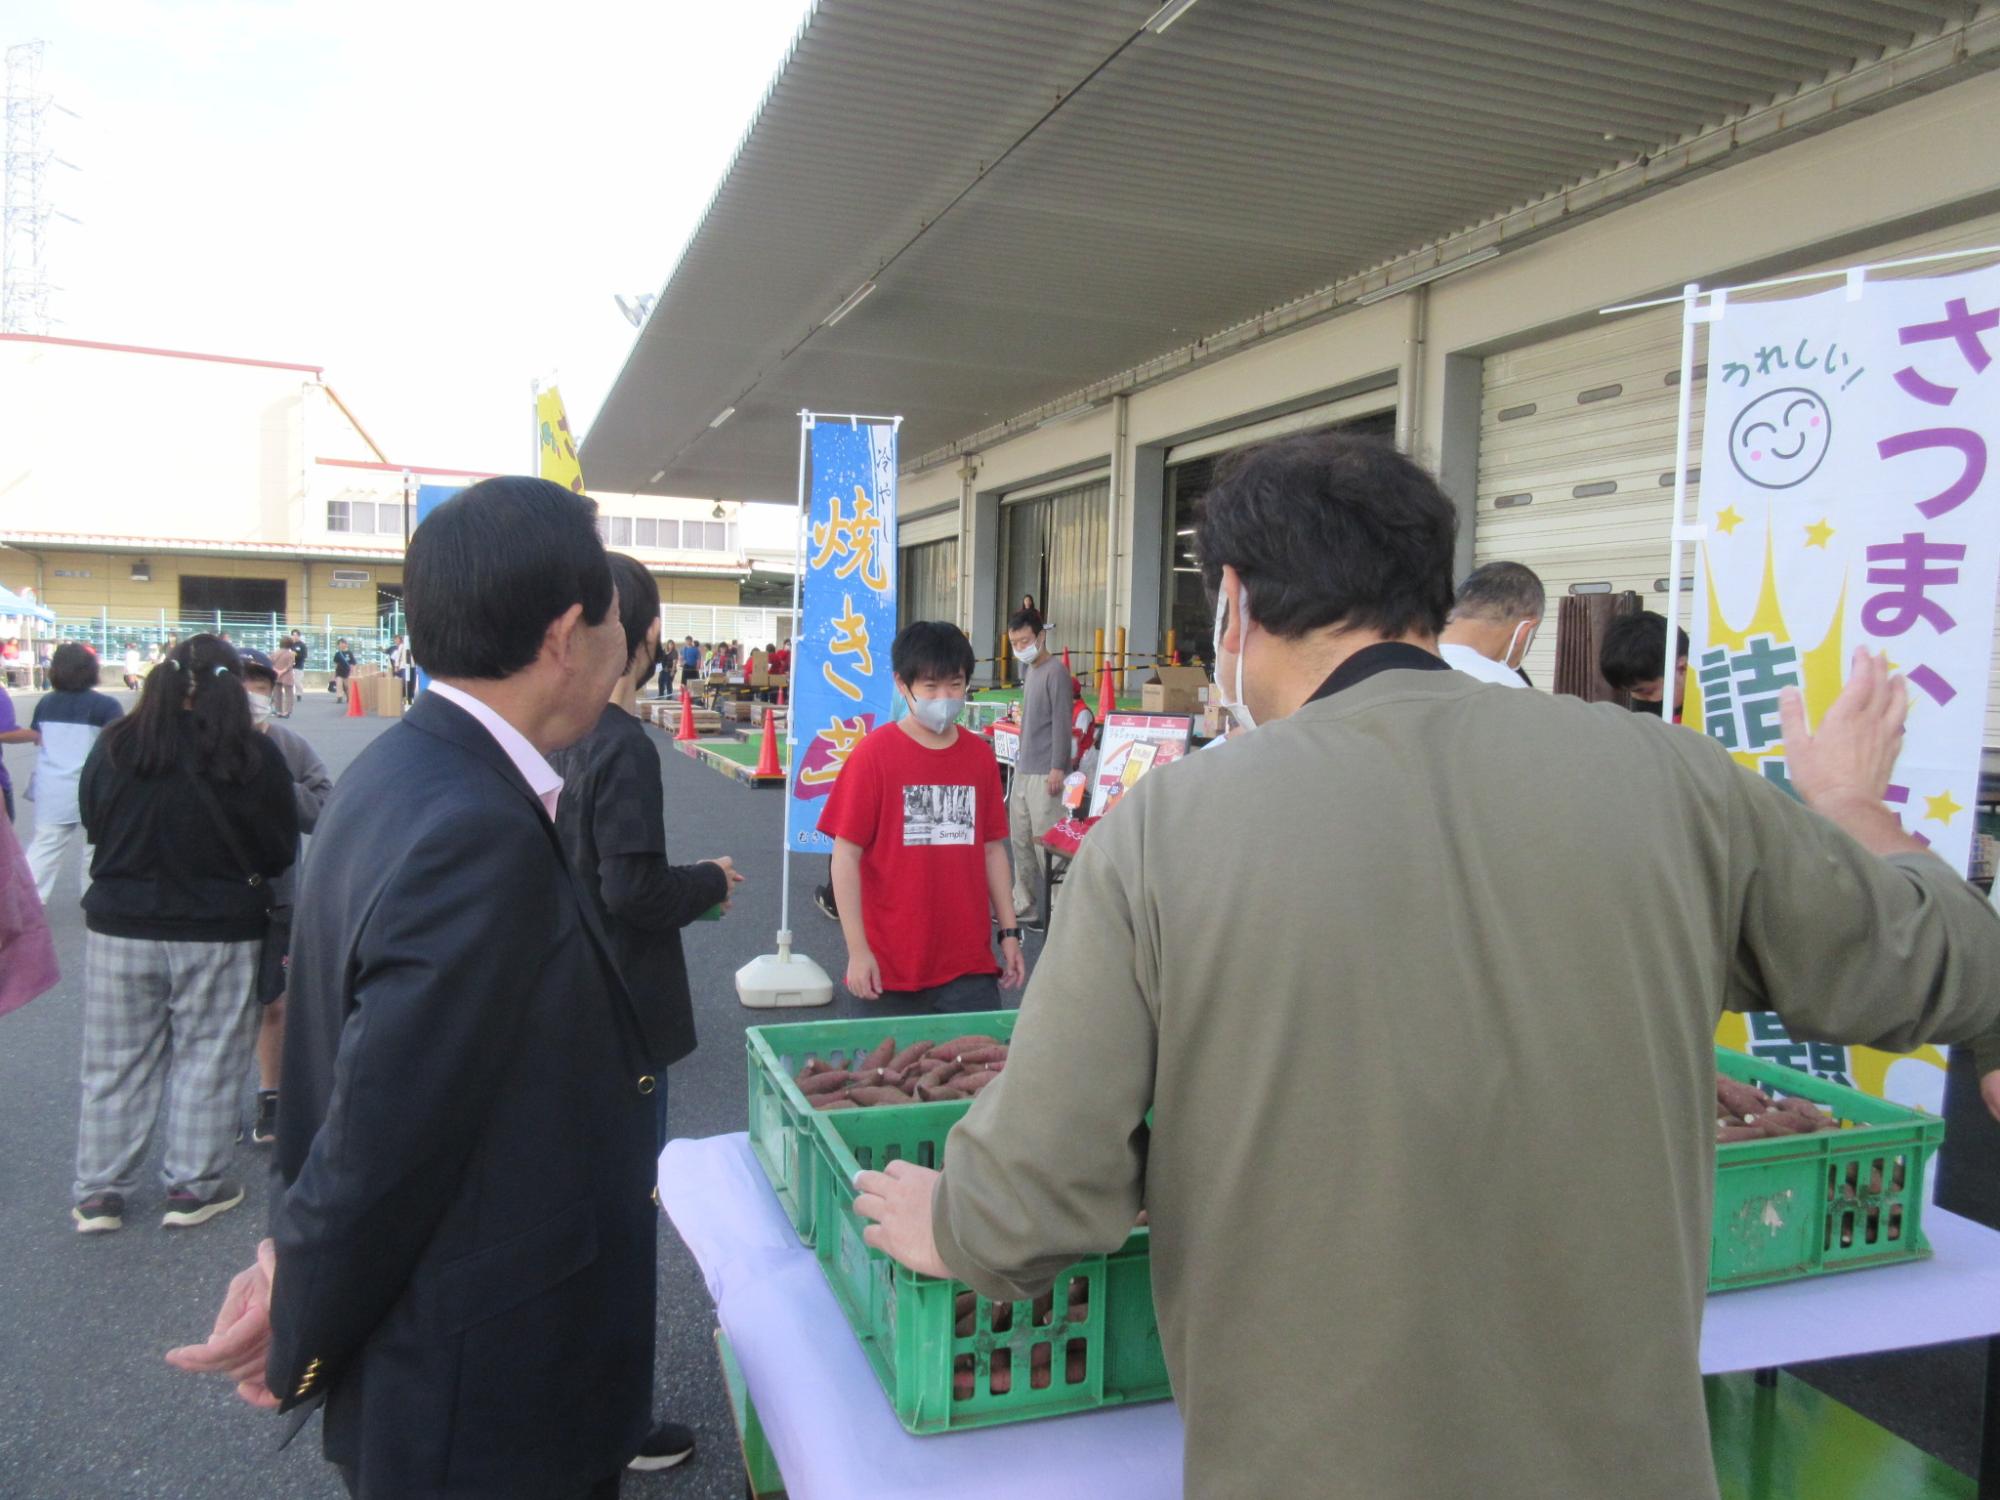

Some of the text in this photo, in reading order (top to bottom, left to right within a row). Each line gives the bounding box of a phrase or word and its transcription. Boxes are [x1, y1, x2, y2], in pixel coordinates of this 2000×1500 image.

[876, 446, 892, 543] 冷やし
[939, 830, 968, 840] Simplify
